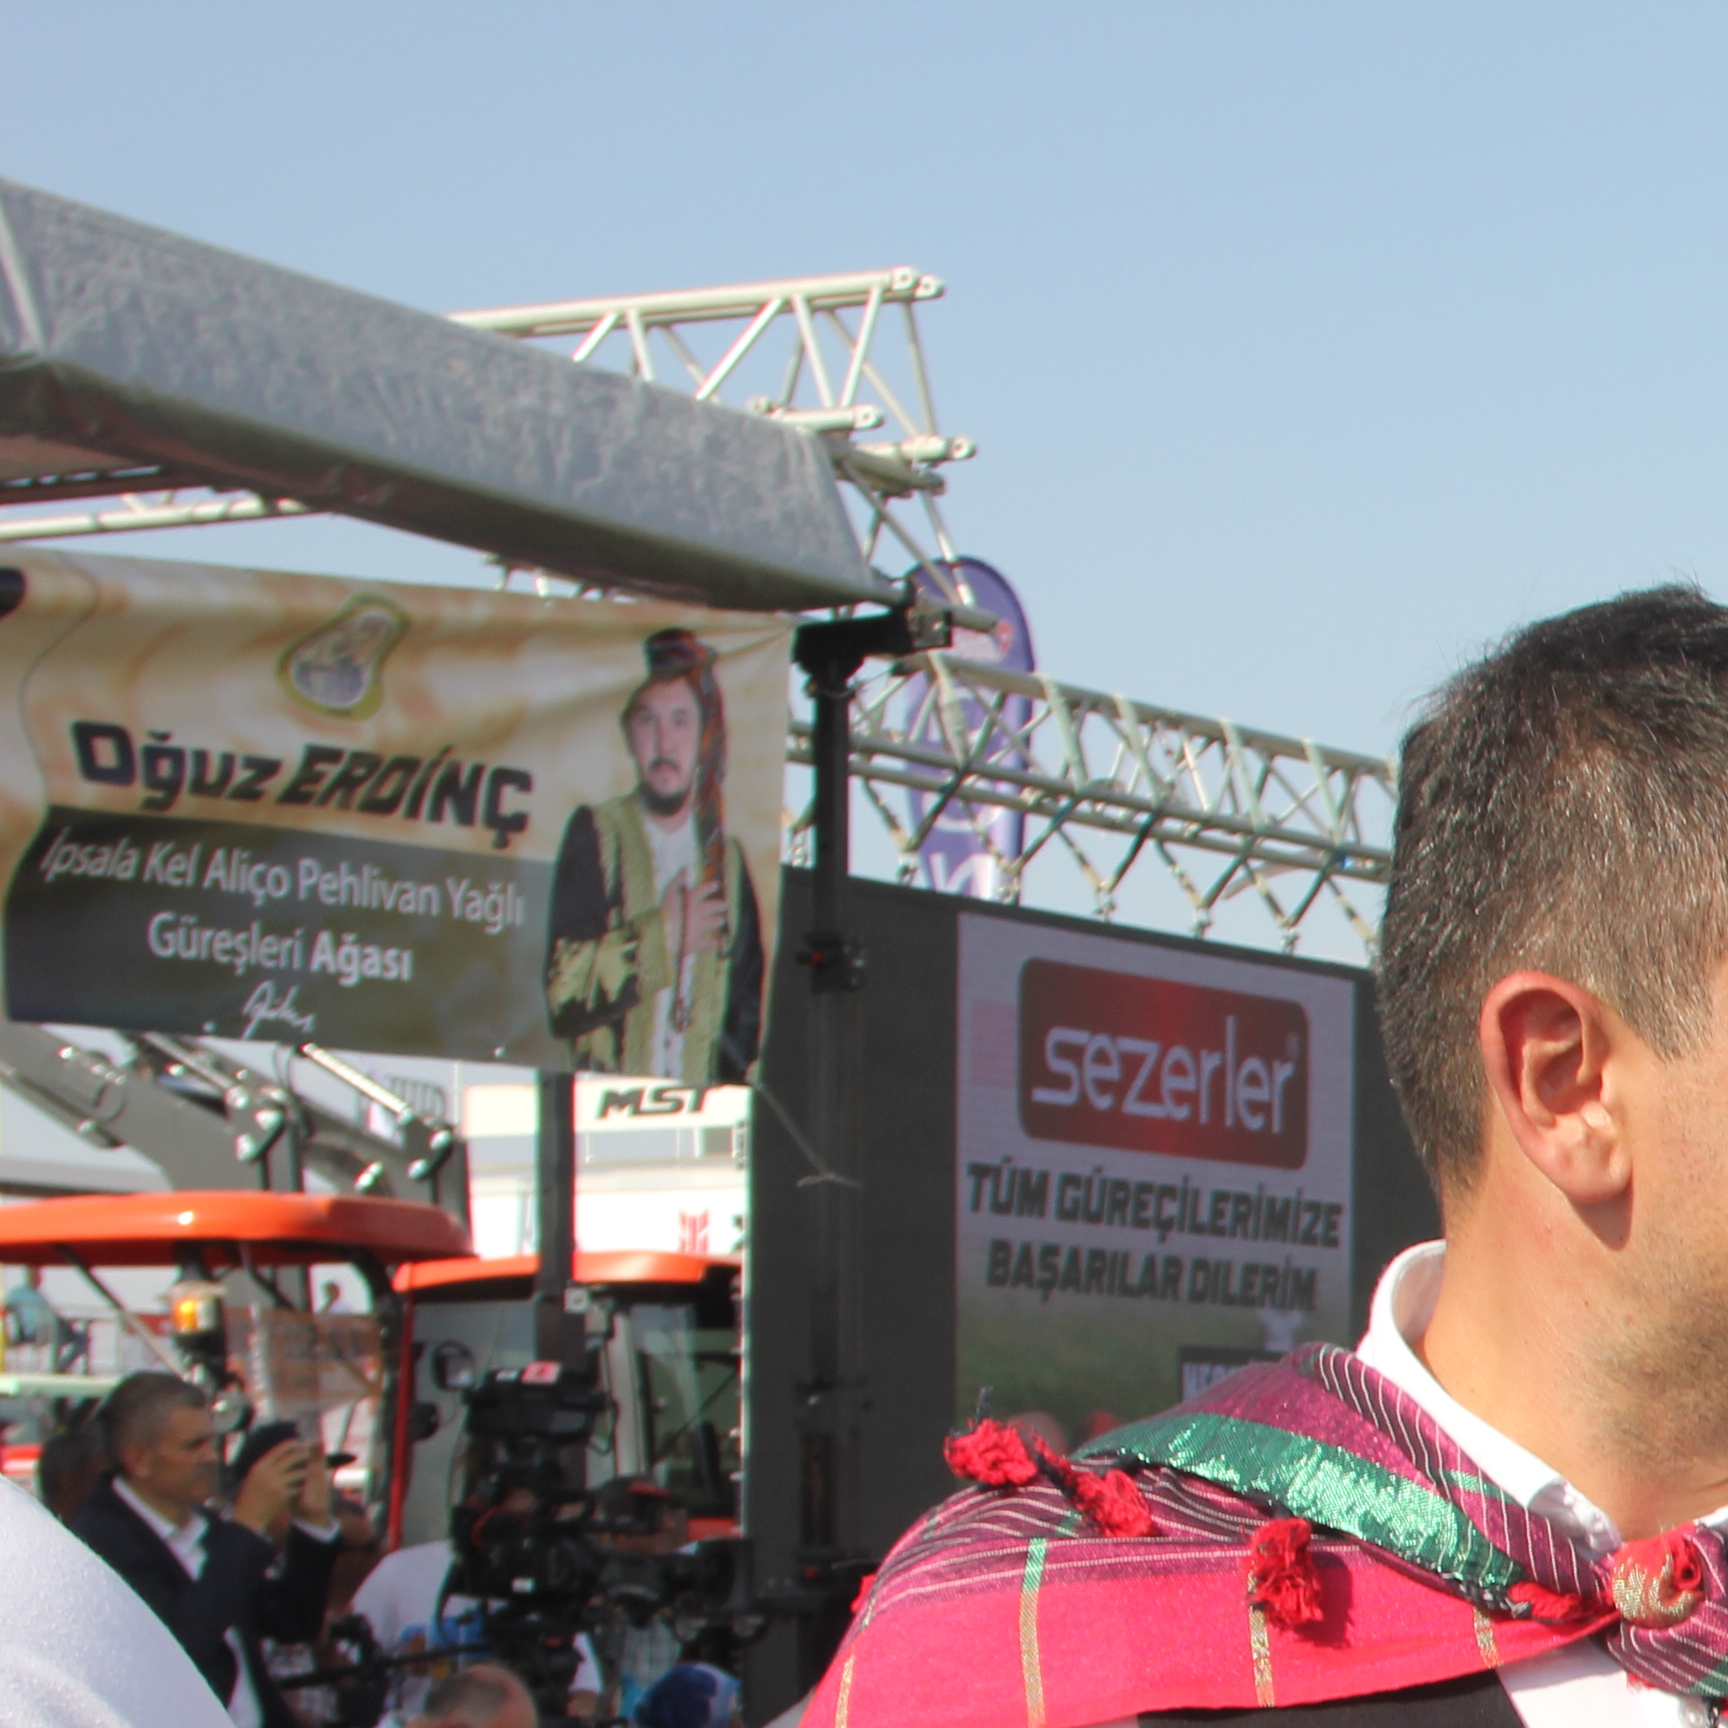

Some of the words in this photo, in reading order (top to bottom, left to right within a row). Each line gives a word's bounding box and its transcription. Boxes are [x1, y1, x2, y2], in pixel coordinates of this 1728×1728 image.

[71, 721, 281, 811] Oğuz
[276, 743, 532, 848] ERDİNÇ
[40, 827, 138, 883] İpsala
[143, 842, 197, 886] Kel
[204, 846, 290, 906] Aliço
[298, 857, 440, 916] Pehlivan
[446, 875, 525, 934] Yağlı
[148, 911, 303, 975] Güreşleri
[311, 930, 413, 986] Ağası
[595, 1085, 709, 1119] MST
[1030, 1015, 1296, 1134] sezerler
[967, 1156, 1050, 1219] TÜM
[985, 1238, 1183, 1304] BAŞARILAR
